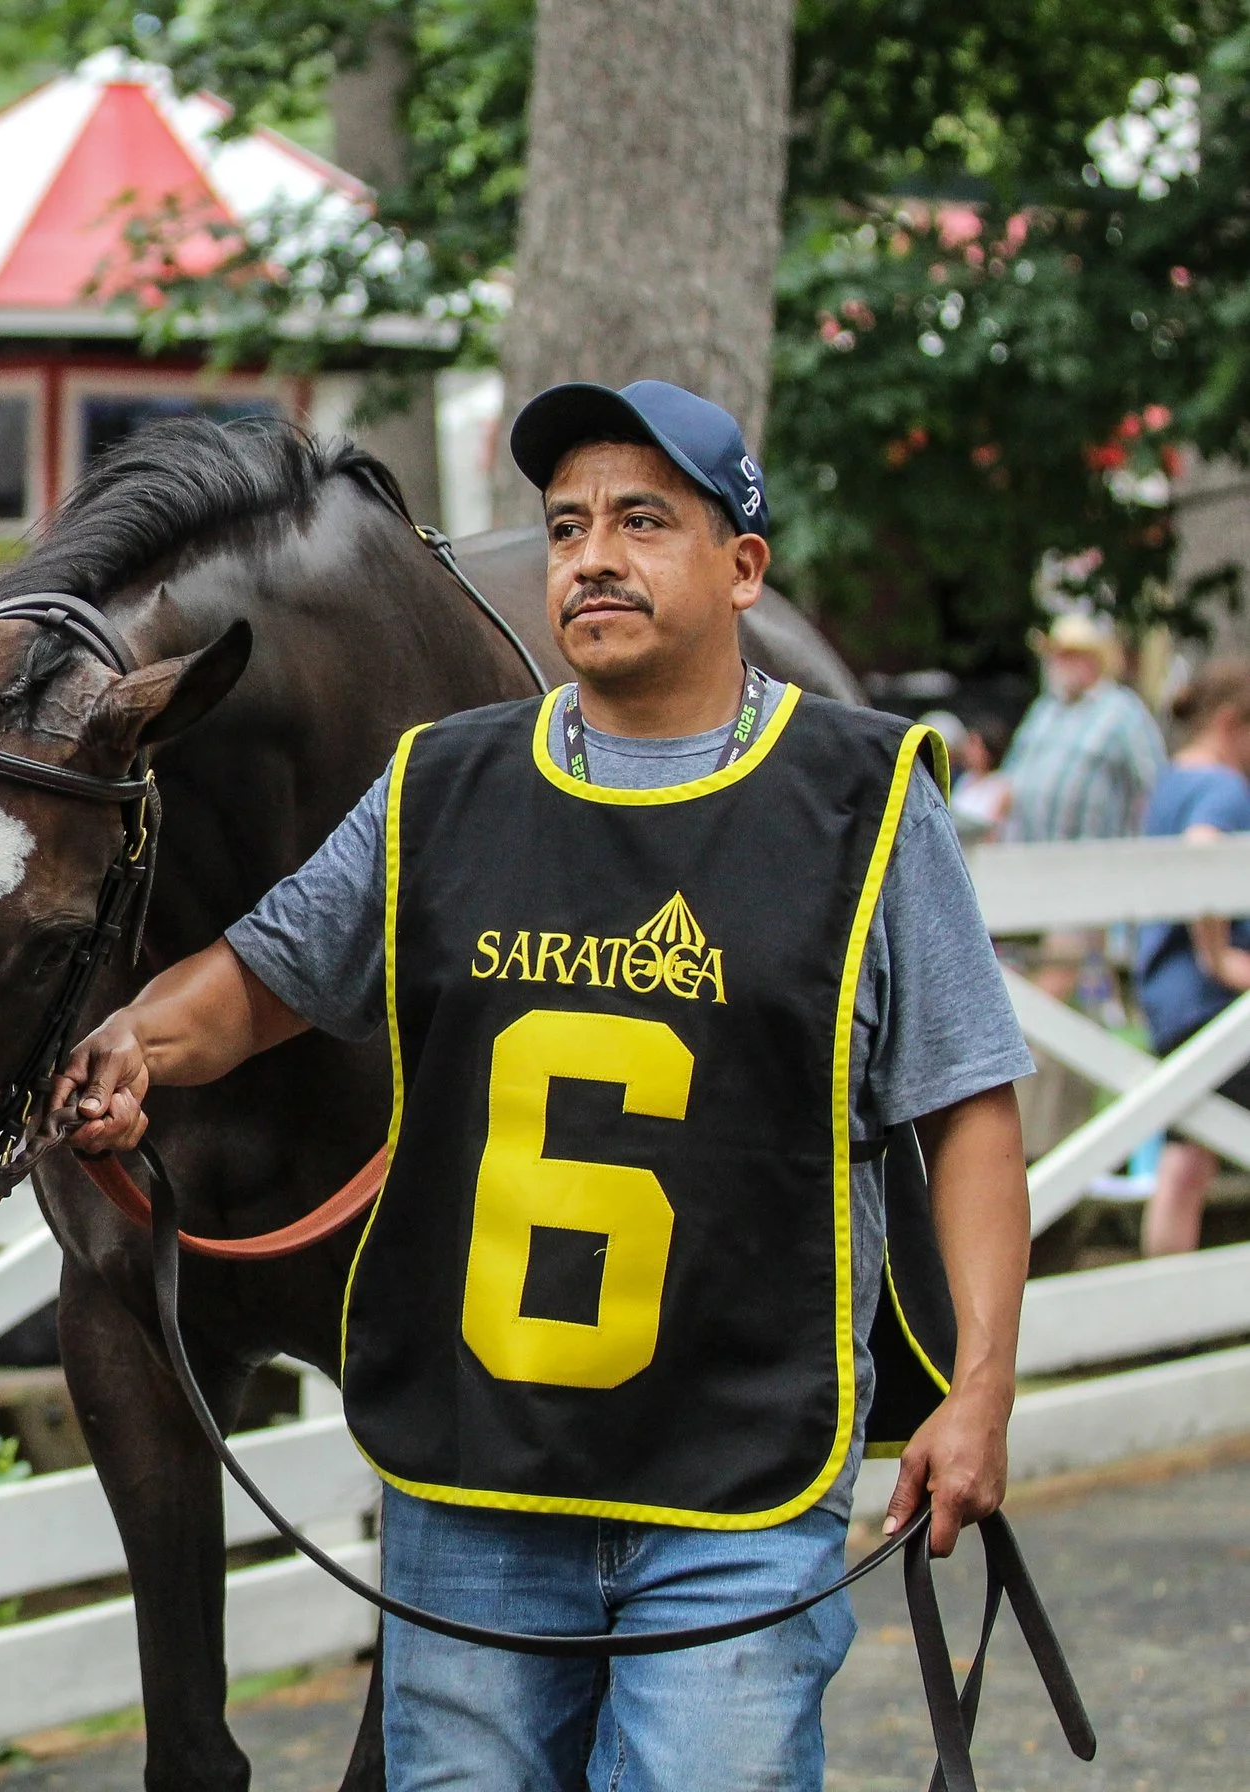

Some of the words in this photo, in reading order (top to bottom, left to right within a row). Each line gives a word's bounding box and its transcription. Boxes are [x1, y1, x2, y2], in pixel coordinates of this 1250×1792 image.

[734, 704, 757, 743] 2025
[471, 930, 728, 1004] SARATOGA
[462, 1008, 695, 1389] 6
